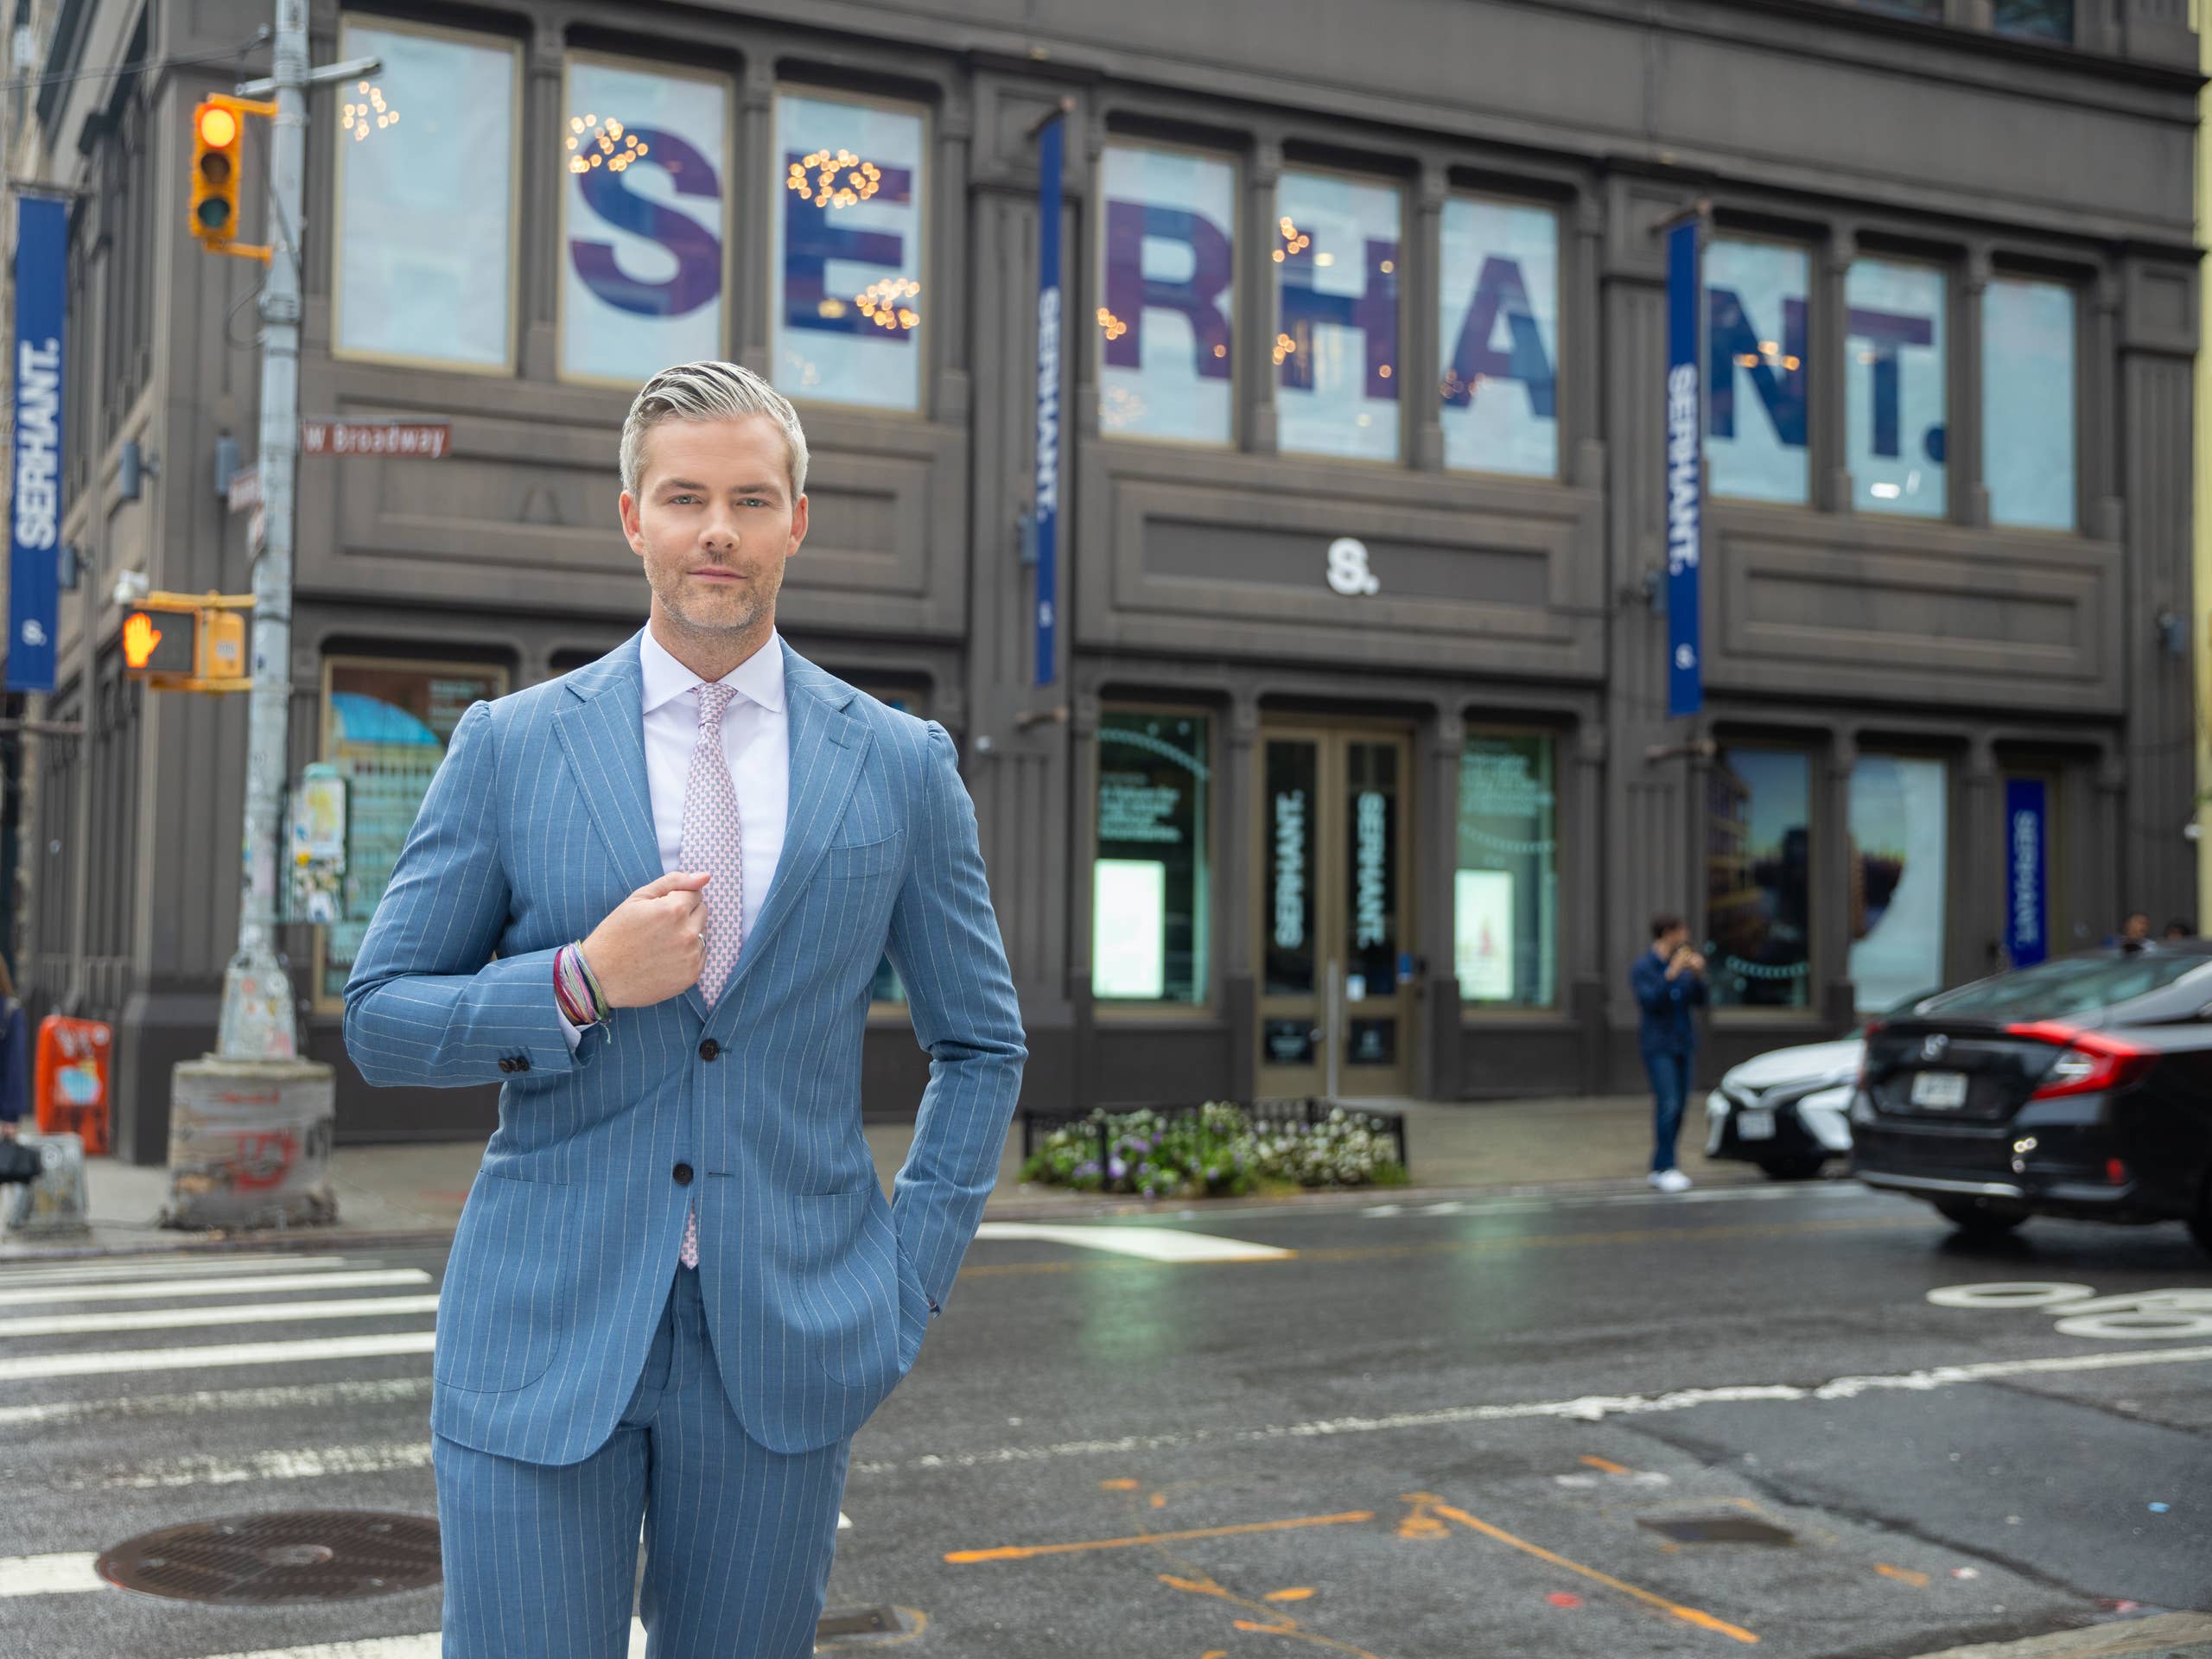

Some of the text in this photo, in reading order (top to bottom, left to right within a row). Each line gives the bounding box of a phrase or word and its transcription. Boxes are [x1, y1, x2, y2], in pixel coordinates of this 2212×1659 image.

[570, 122, 1947, 463] SERHANT.
[16, 337, 60, 550] SERHANT.
[305, 423, 446, 459] W Broadway
[1669, 363, 1700, 576] SERHANT.
[1327, 537, 1381, 595] S.
